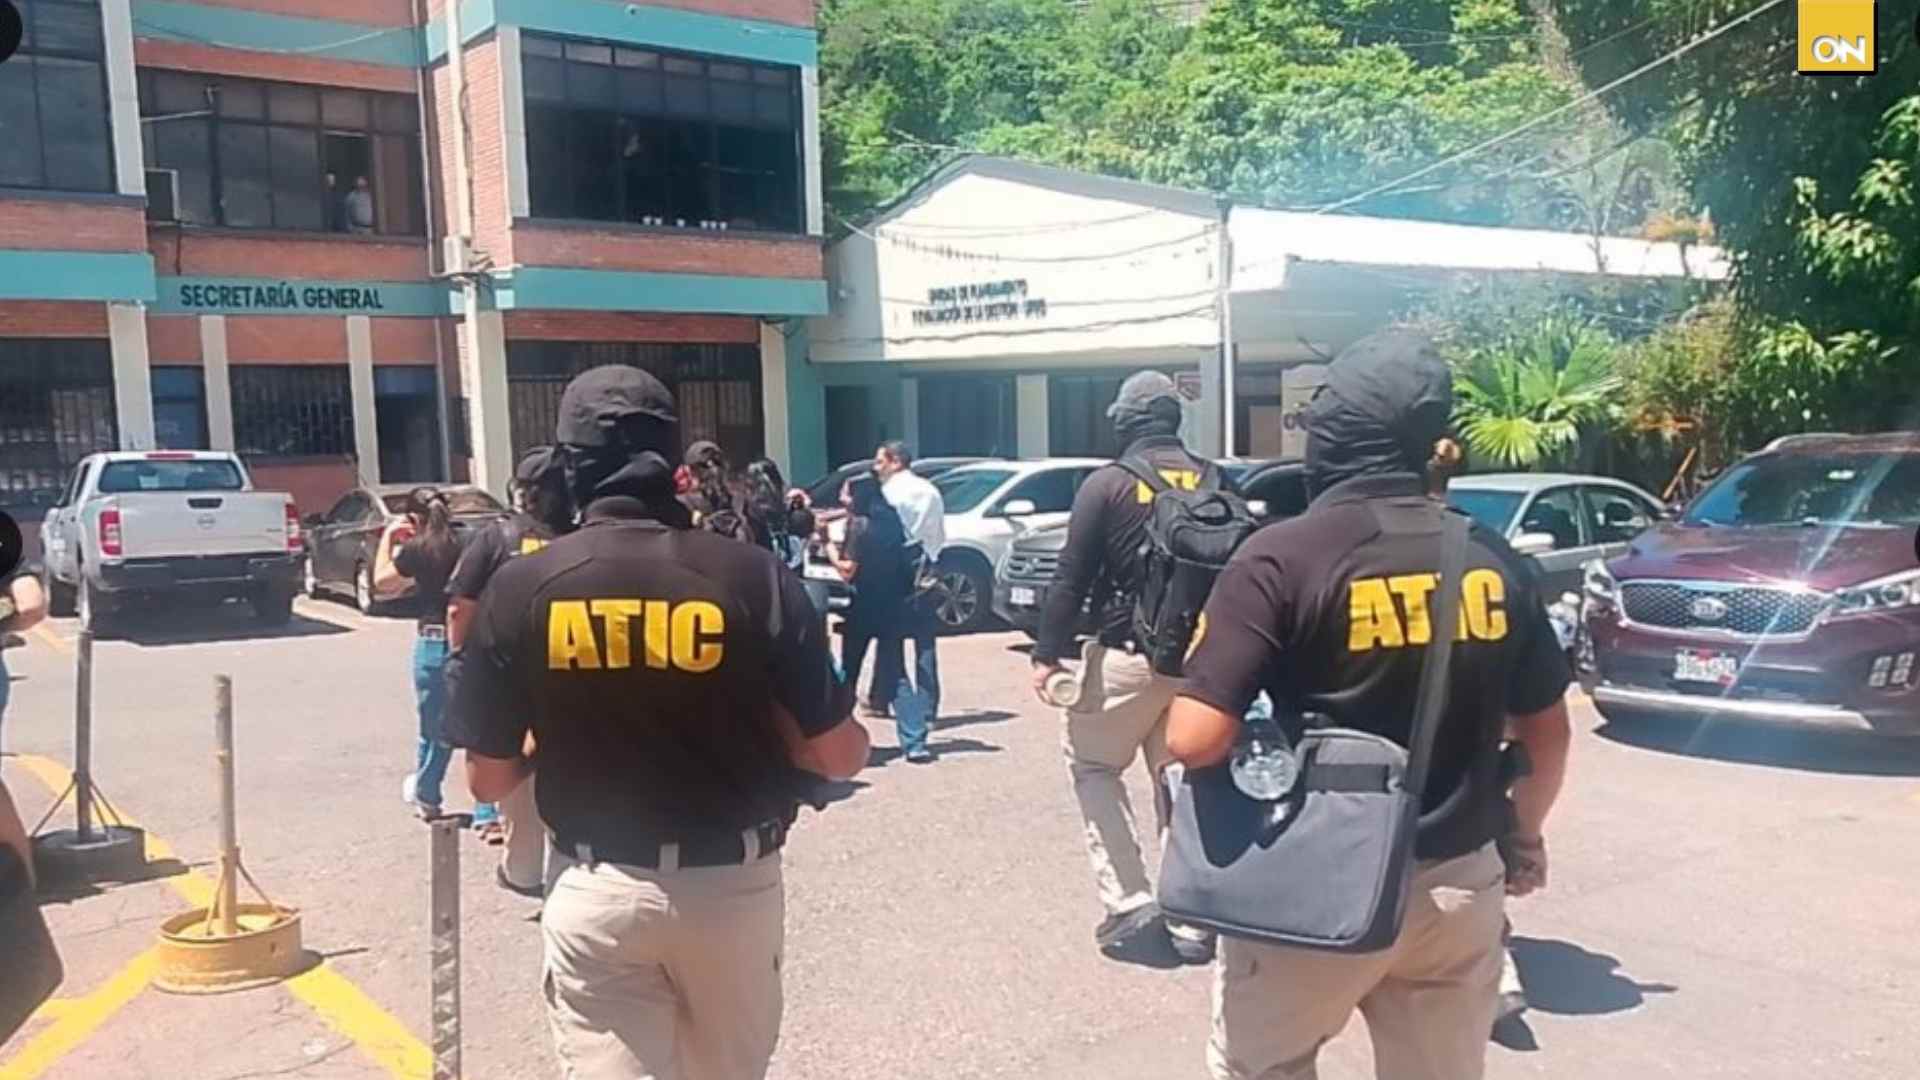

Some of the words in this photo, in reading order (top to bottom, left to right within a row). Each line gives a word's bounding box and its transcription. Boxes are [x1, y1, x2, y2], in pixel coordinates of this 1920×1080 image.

[179, 281, 298, 308] SECRETARÍA
[302, 287, 383, 309] GENERAL
[548, 599, 724, 673] ATIC
[1349, 568, 1508, 650] ATC
